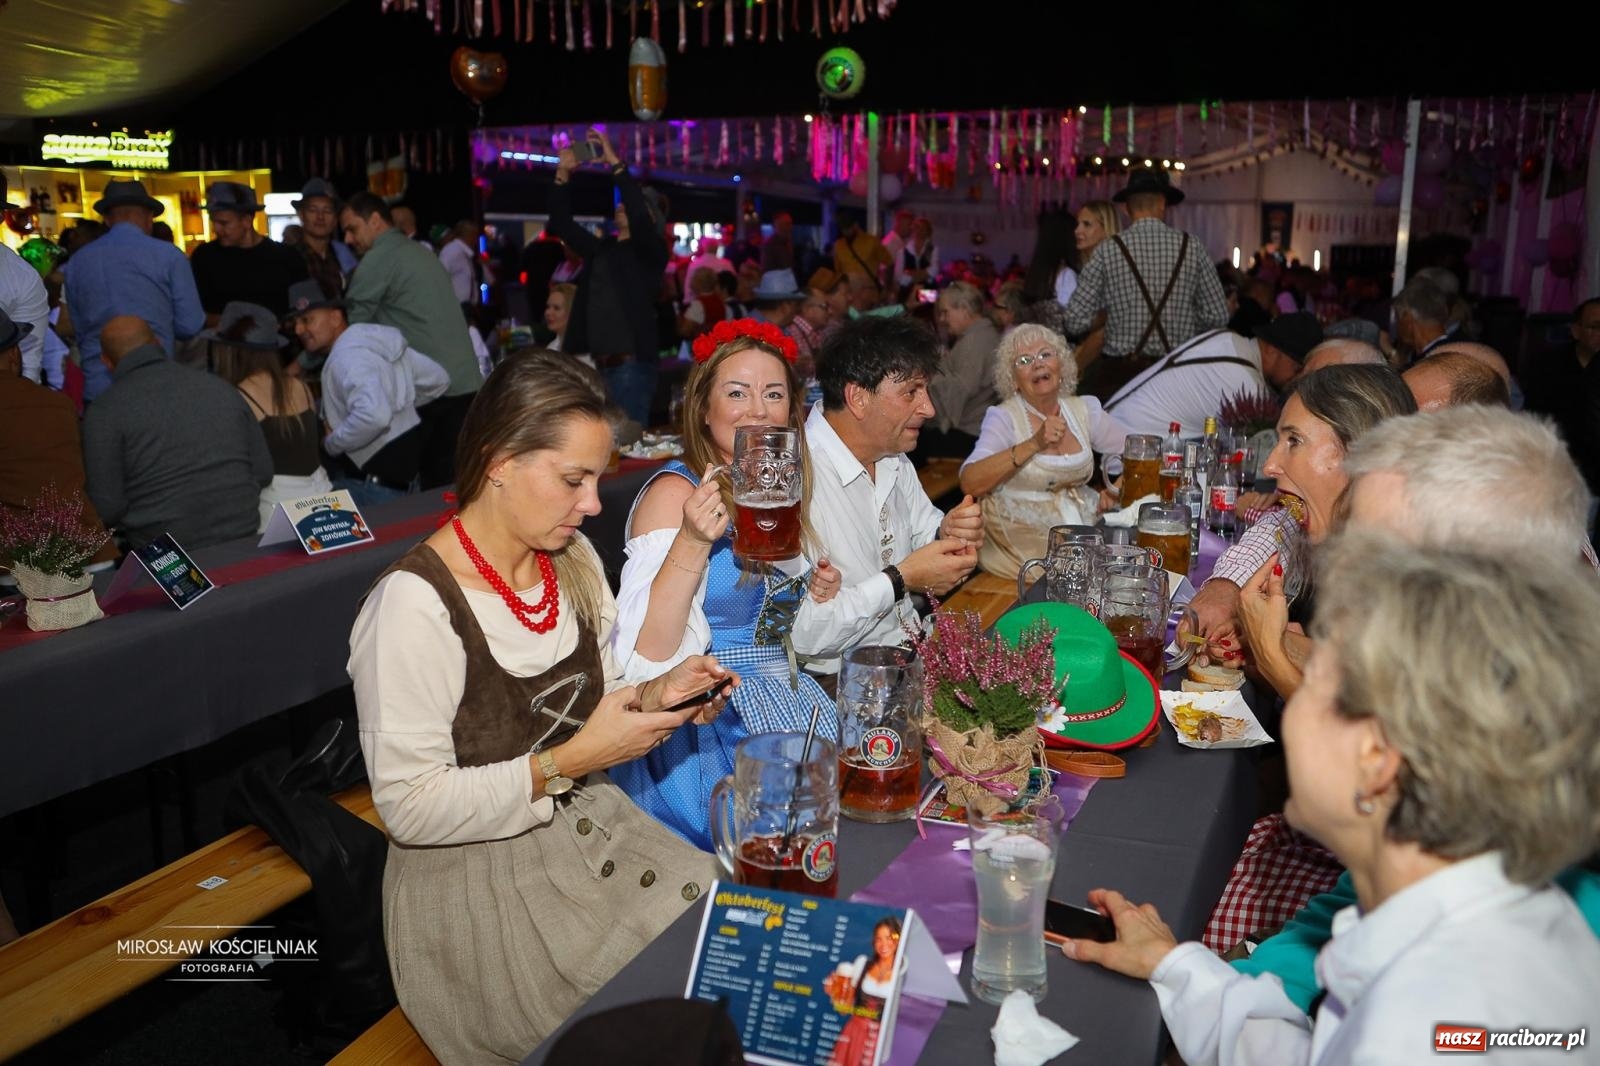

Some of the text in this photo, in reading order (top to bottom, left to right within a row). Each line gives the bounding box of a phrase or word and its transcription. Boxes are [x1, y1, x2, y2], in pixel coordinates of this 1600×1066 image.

[294, 496, 338, 510] Oktoberfest
[150, 550, 180, 572] KONKURS
[170, 563, 189, 578] EVENTY
[864, 729, 899, 743] PAULANER
[715, 891, 786, 916] Oktoberfest
